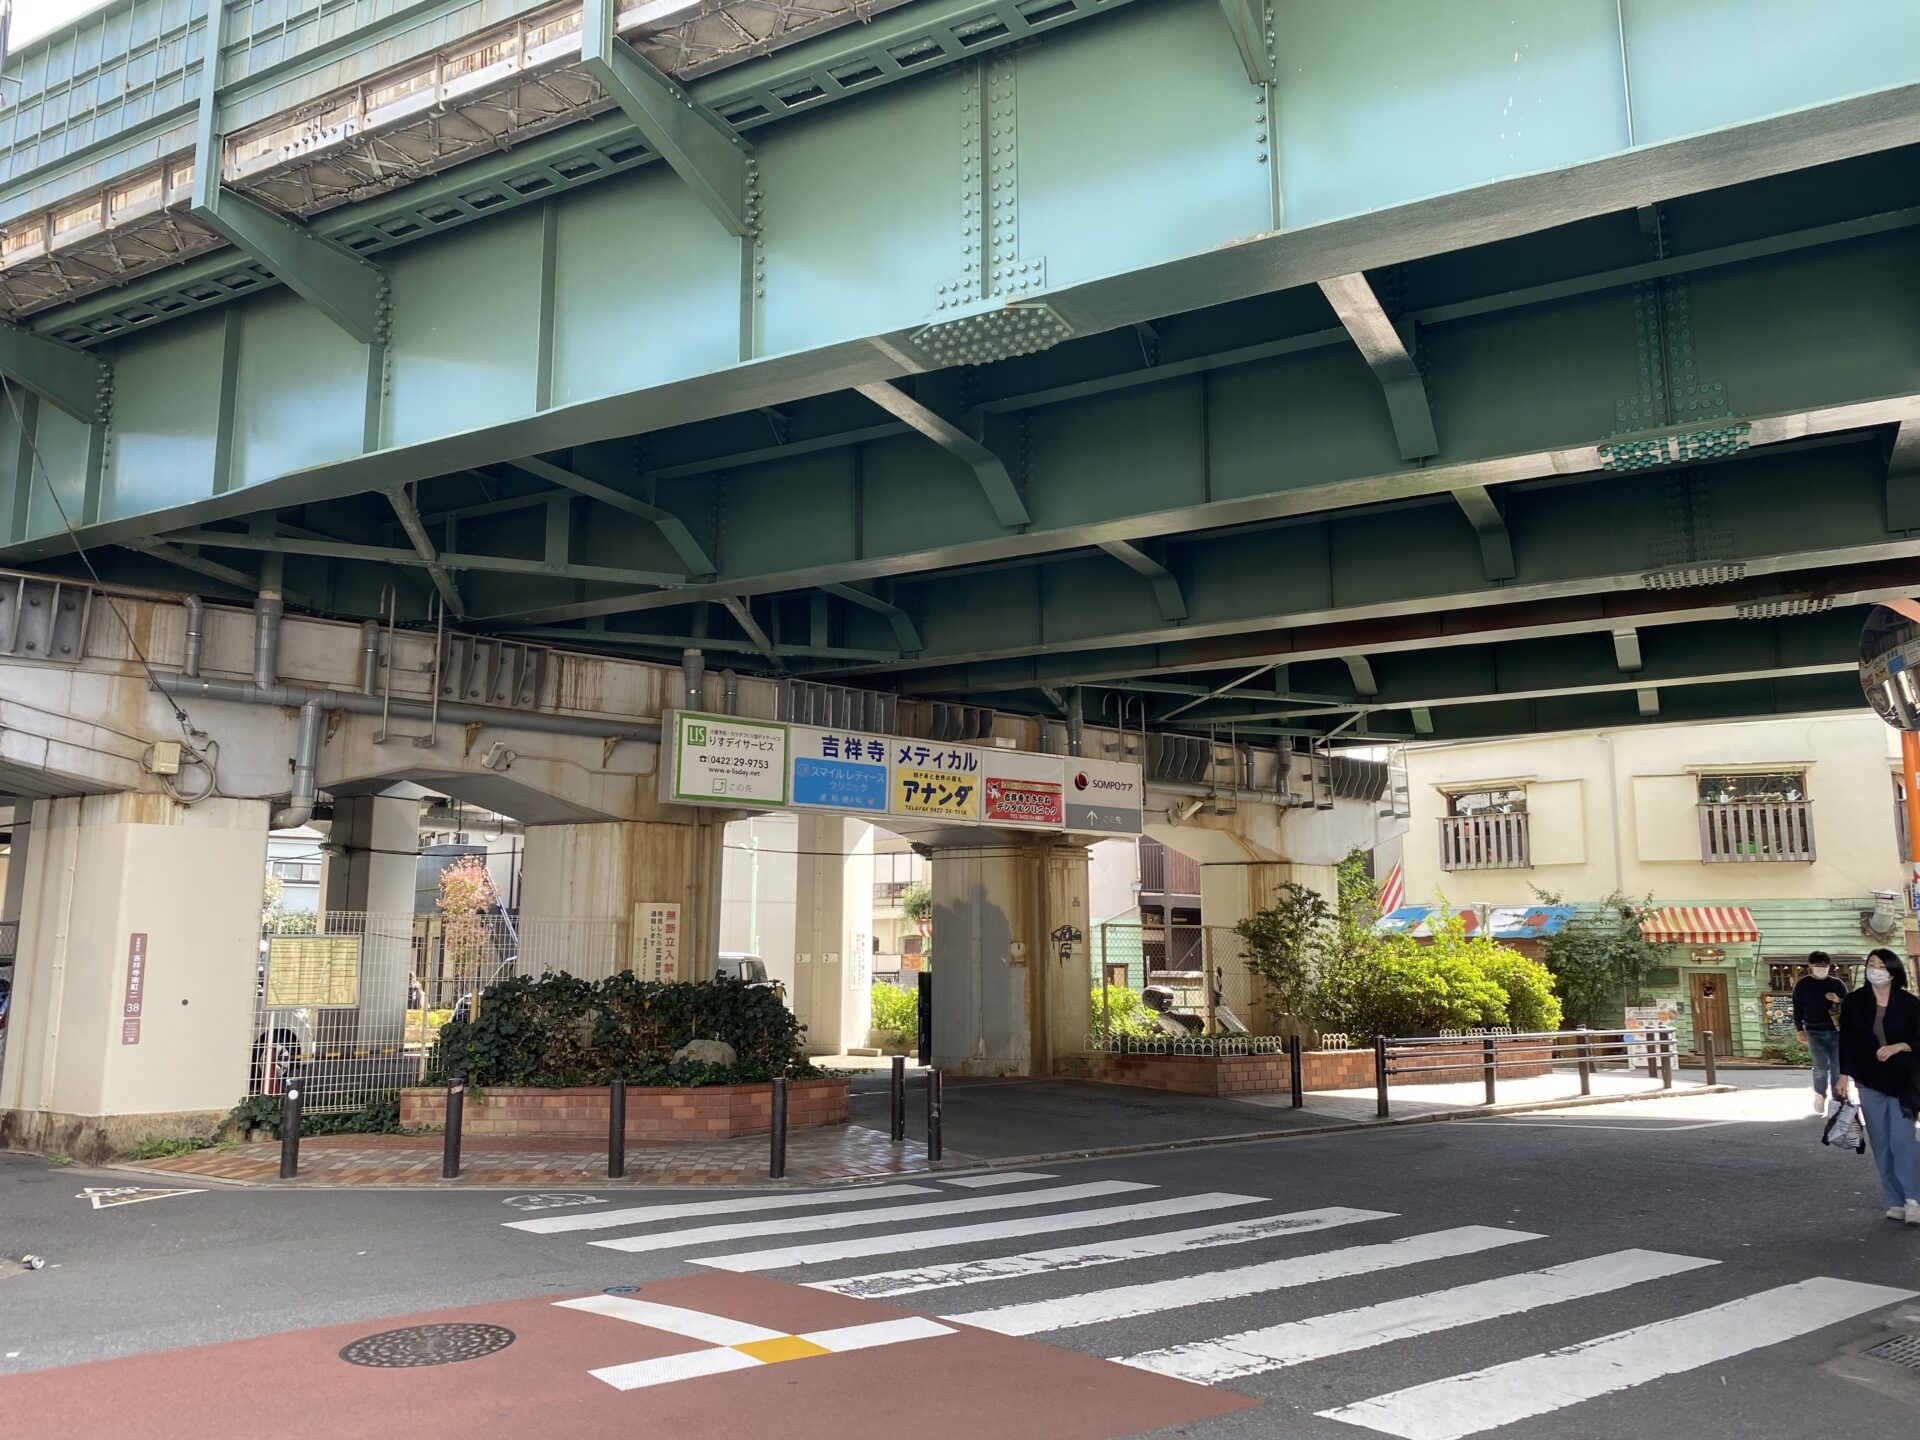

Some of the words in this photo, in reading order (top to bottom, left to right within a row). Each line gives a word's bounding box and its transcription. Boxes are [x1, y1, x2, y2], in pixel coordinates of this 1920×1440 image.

[689, 726, 704, 742] LIS
[709, 736, 774, 751] りすデイサービス
[821, 735, 885, 762] 吉祥寺
[898, 745, 978, 772] メディカル
[707, 755, 769, 769] (0422)29-9753
[708, 767, 760, 777] www.e-lisday.net
[811, 767, 885, 783] スマイルレディース
[729, 783, 752, 792] この先
[830, 781, 867, 792] クリニック
[1092, 780, 1133, 791] SOMPOケア
[903, 780, 973, 807] アナンダ
[664, 910, 676, 984] 無断立入禁止
[126, 1003, 140, 1013] 38
